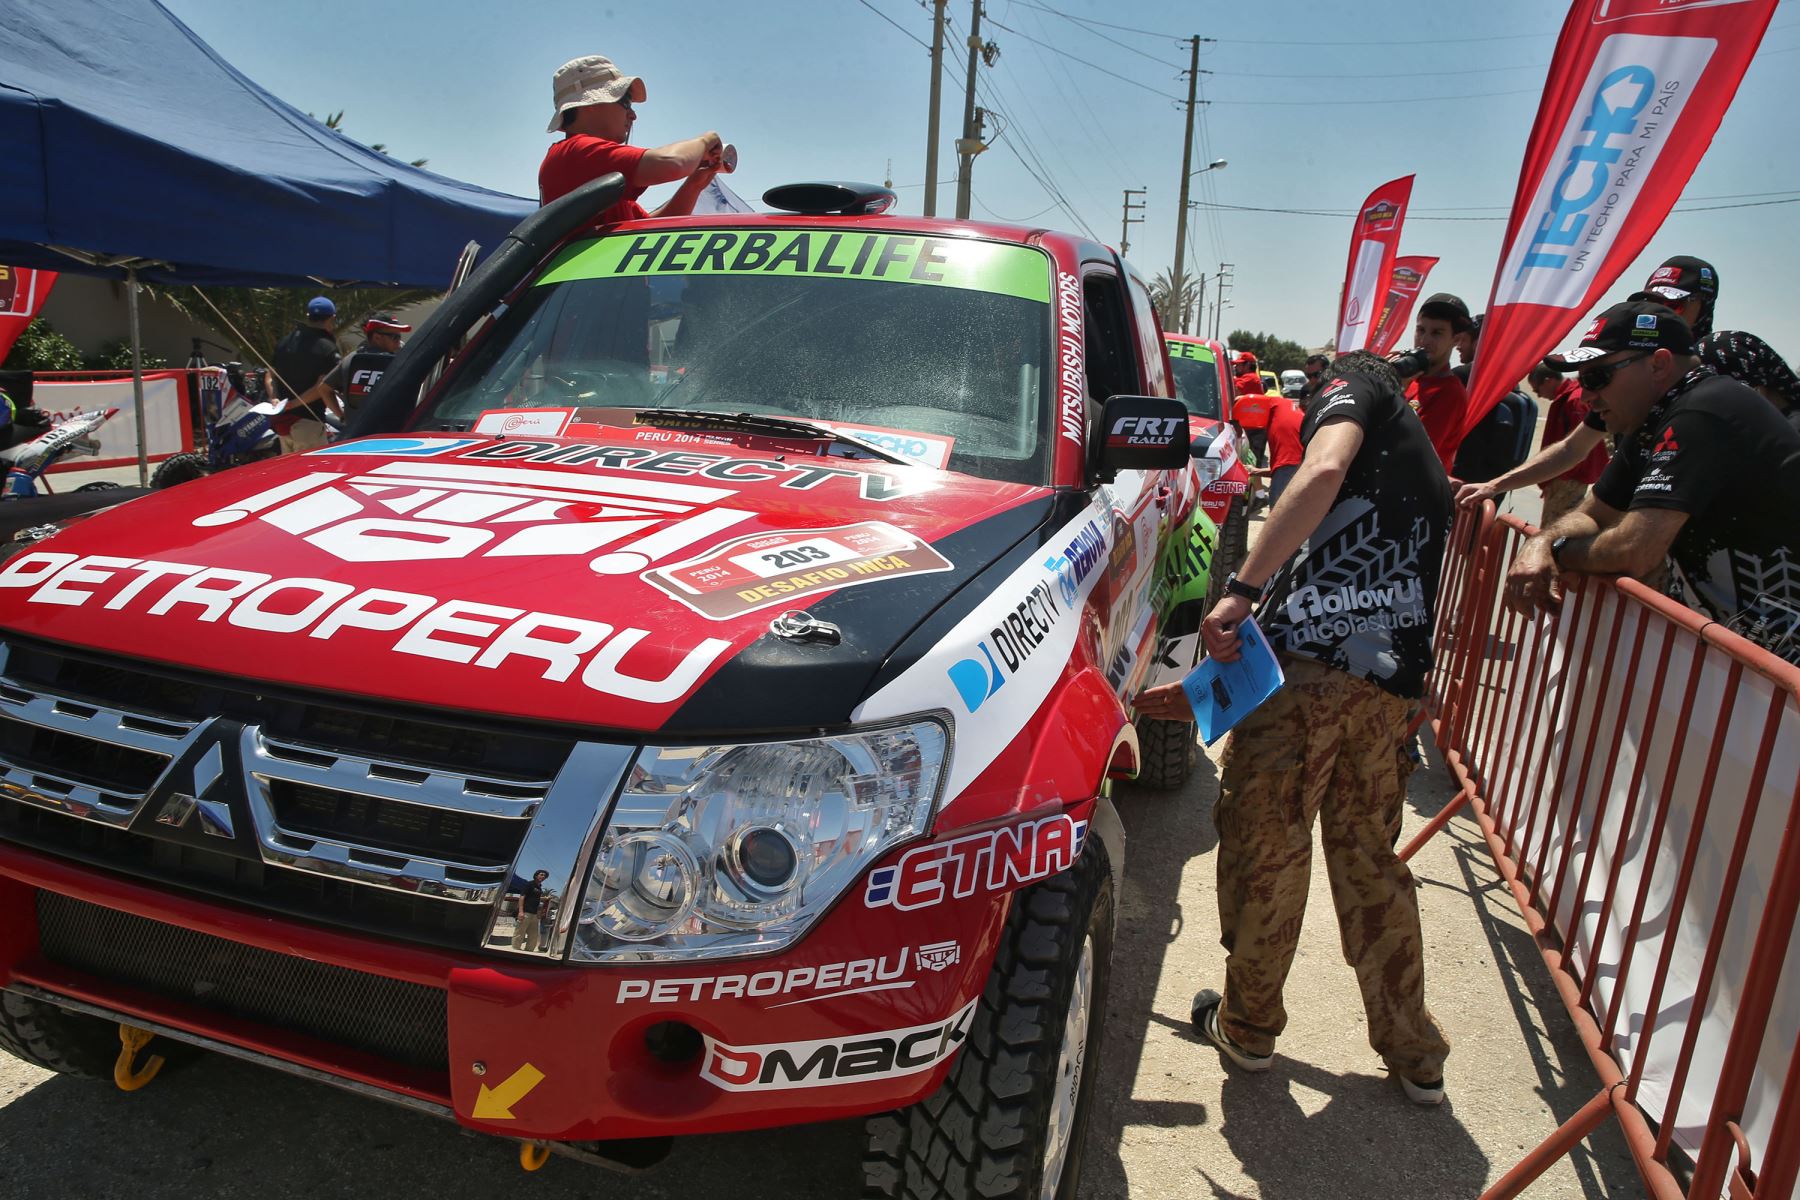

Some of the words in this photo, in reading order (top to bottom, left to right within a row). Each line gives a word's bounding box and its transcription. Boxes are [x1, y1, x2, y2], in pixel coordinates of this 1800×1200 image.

[1515, 65, 1655, 281] TECHO
[1570, 250, 1590, 272] UN
[1585, 193, 1619, 245] TECHO
[1616, 145, 1646, 187] PARA
[1640, 122, 1658, 139] MI
[1652, 80, 1680, 116] PAÍS
[614, 232, 949, 282] HERBALIFE
[1059, 271, 1082, 339] MOTORS
[1062, 335, 1083, 447] MITSUBISHI
[635, 430, 673, 442] PERÚ
[673, 433, 701, 444] 2014
[1111, 416, 1185, 436] FRT
[1127, 436, 1174, 445] RALLY
[697, 570, 732, 583] 2014
[736, 567, 849, 604] DESAFIO
[847, 555, 912, 575] INCA
[761, 545, 830, 569] 203
[1063, 519, 1107, 586] RENOVA
[0, 552, 730, 704] PETROPERU
[990, 579, 1060, 674] DIRECTV
[894, 814, 1072, 911] ETNA
[615, 946, 910, 1004] PETROPERU
